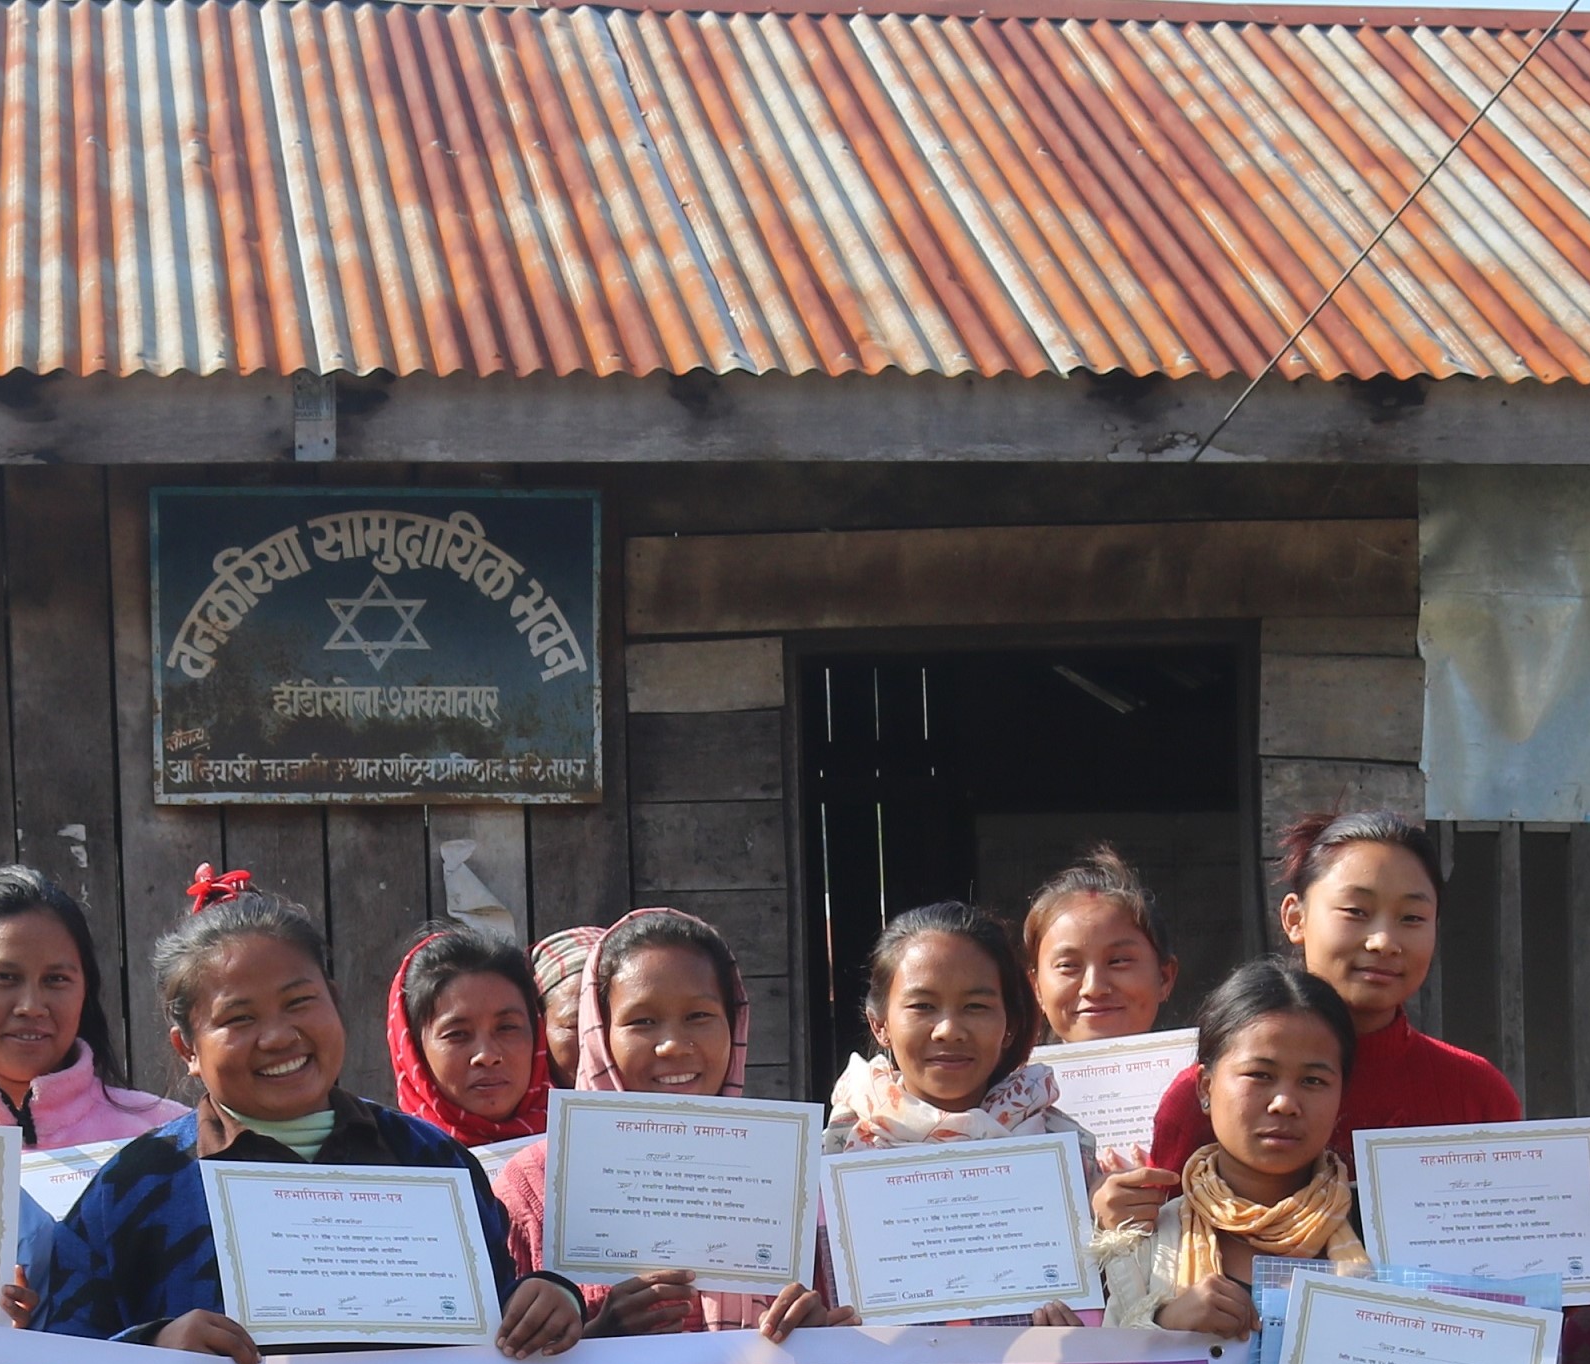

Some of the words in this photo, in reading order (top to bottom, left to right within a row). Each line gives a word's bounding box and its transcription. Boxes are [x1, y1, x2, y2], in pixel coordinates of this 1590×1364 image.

[166, 526, 312, 679] वनकरिया
[308, 510, 526, 601] सामुदायिक
[509, 578, 588, 683] भवन
[616, 1119, 687, 1136] सहभागिताको
[693, 1124, 748, 1140] प्रमाण-पत्र
[1419, 1150, 1487, 1167] सहभागिताको
[1493, 1149, 1543, 1162] प्रमाण-पत्र
[886, 1167, 954, 1186] सहभागिताको
[960, 1164, 1011, 1179] प्रमाण-पत्र
[274, 1187, 343, 1202] सहभागिताको
[350, 1191, 403, 1204] प्रमाण-पत्र
[1355, 1308, 1426, 1331] सहभागिताको
[1431, 1320, 1485, 1340] प्रमाण-पत्र
